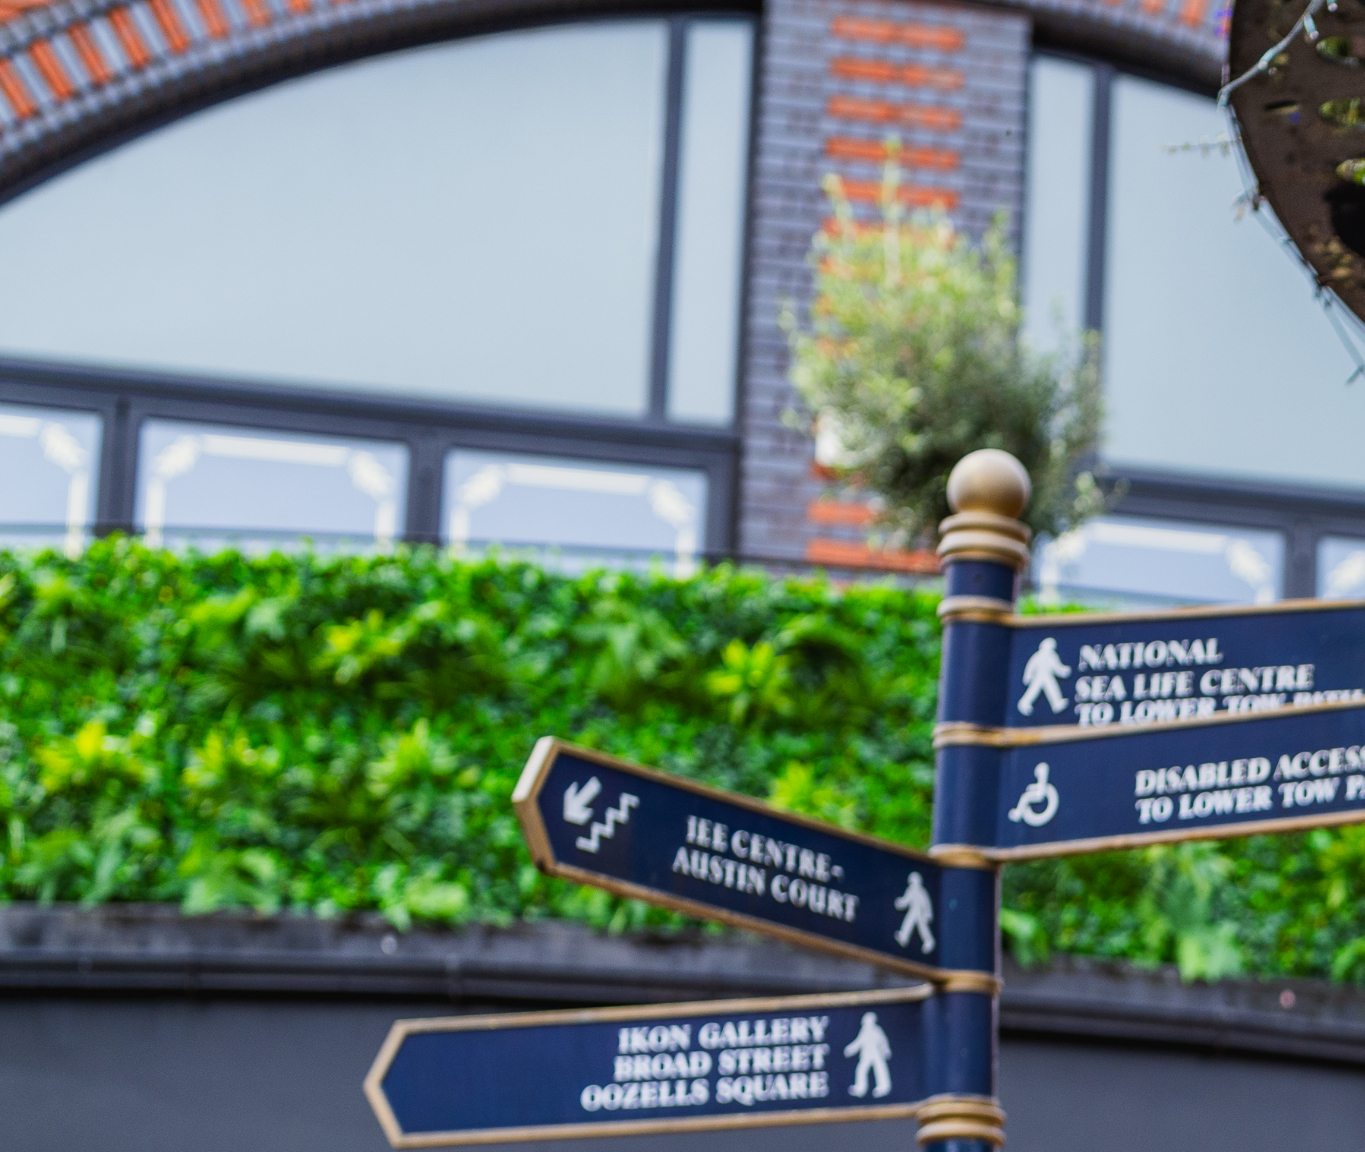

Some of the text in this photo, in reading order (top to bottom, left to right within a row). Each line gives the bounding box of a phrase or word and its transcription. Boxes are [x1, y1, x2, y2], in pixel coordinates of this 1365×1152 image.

[1079, 637, 1224, 672] NATIONAL
[1074, 664, 1316, 703] SEA LIFE CENTRE
[1074, 702, 1115, 728] TO
[1119, 697, 1217, 725] LOWER
[1135, 756, 1271, 797] DISABLED
[1135, 797, 1174, 824] TO
[1178, 785, 1274, 820] LOWER
[1278, 777, 1341, 808] TOW
[686, 814, 845, 883] IEE CENTRE-
[672, 846, 860, 922] AUSTIN COURT
[618, 1015, 830, 1054] IKON GALLERY
[613, 1043, 831, 1082] BROAD STREET
[580, 1071, 829, 1112] OOZELLS SQUARE
